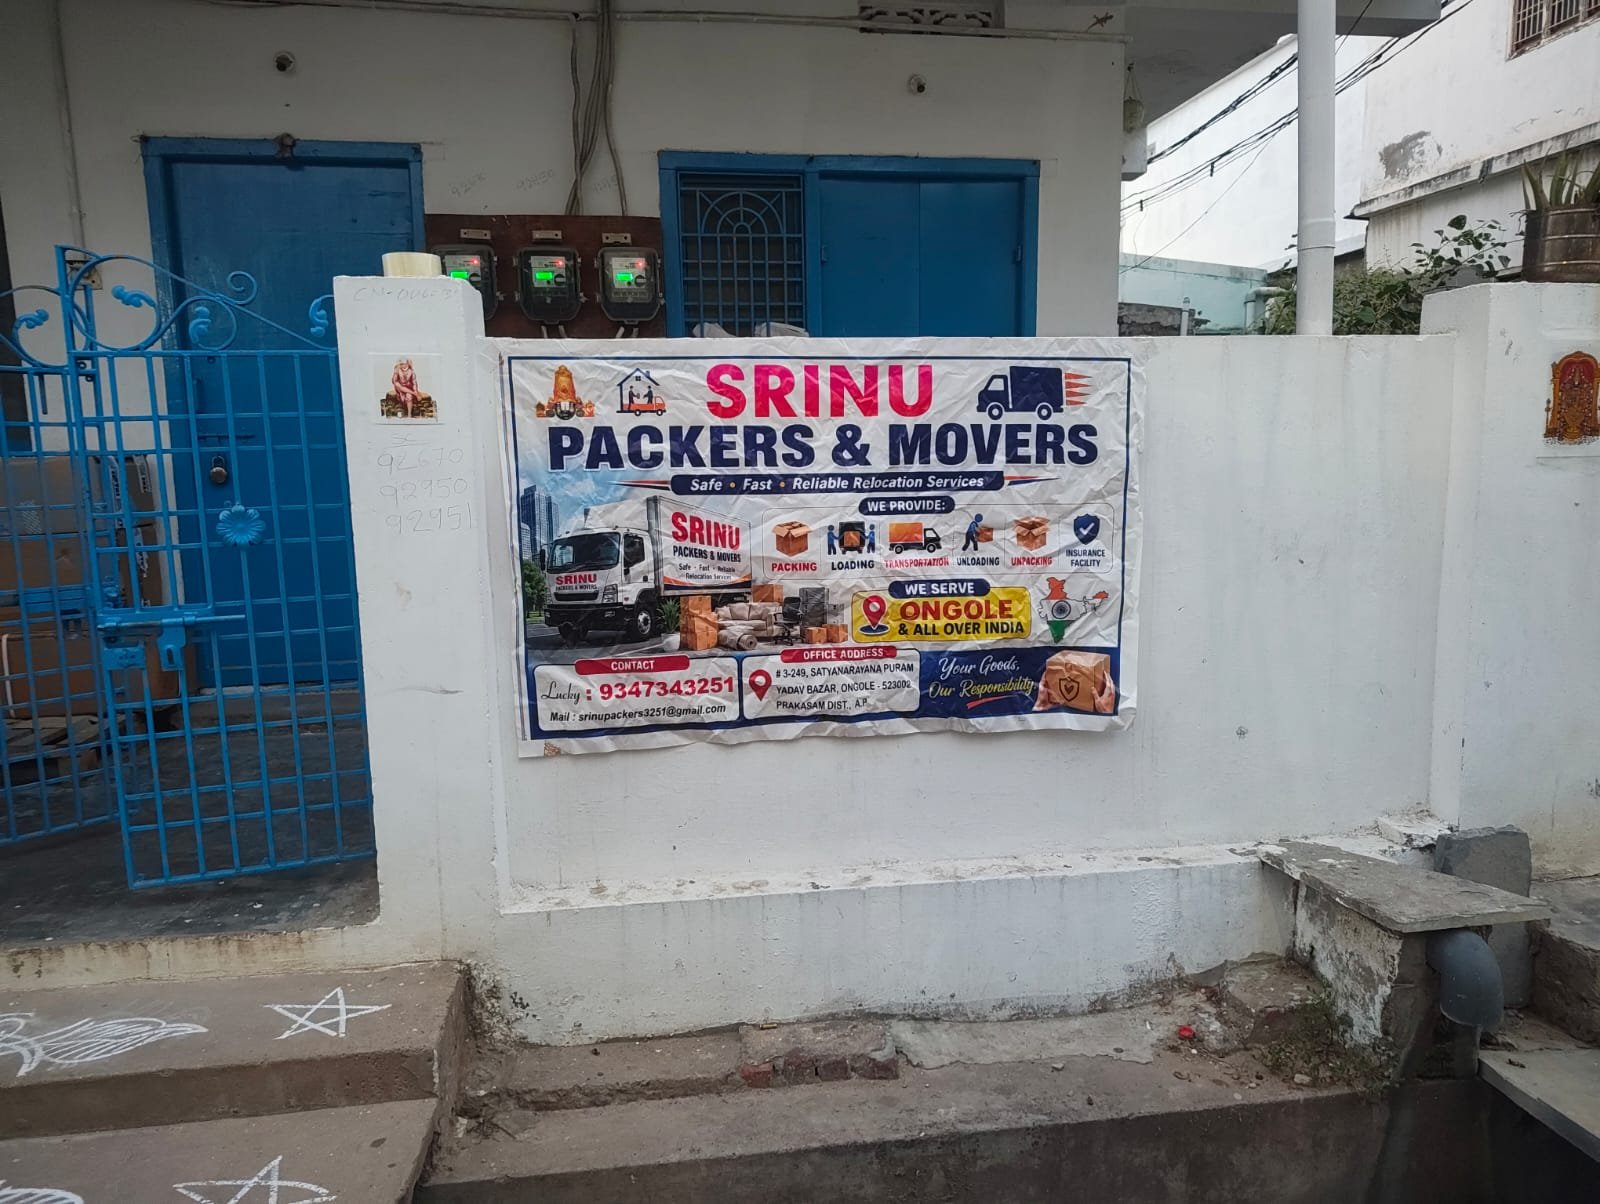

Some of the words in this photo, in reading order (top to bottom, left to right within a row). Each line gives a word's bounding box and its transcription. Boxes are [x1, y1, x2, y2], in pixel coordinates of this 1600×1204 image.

[706, 363, 933, 418] SRINU
[548, 424, 815, 470] PACKERS
[831, 424, 872, 467] &
[888, 423, 1098, 466] MOVERS
[690, 478, 723, 492] Safe
[743, 478, 772, 491] Fast
[793, 477, 849, 490] Reliable
[852, 475, 922, 489] Relocation
[928, 475, 984, 488] Services
[867, 501, 887, 512] WE
[890, 500, 945, 512] PROVIDE:
[671, 511, 741, 550] SRINU
[673, 545, 708, 559] PACKERS
[709, 550, 715, 560] &
[717, 552, 741, 562] MOVERS
[1066, 549, 1106, 558] INSURANCE
[678, 563, 691, 571] Safe
[771, 562, 817, 571] PACKING
[831, 560, 875, 570] LOADING
[884, 557, 949, 568] TRANSPORTATION
[957, 557, 1000, 566] UNLOADING
[1011, 556, 1053, 566] UNPACKING
[1071, 559, 1101, 567] FACILITY
[556, 573, 597, 585] SRINU
[905, 583, 927, 595] WE
[931, 582, 975, 594] SERVE
[900, 600, 1013, 620] ONGOLE
[898, 623, 906, 635] &
[913, 623, 939, 636] ALL
[944, 622, 980, 635] OVER
[985, 621, 1024, 634] INDIA
[803, 651, 836, 660] OFFICE
[840, 648, 883, 659] ADDRESS
[611, 660, 655, 671] CONTACT
[776, 670, 781, 678] #
[783, 668, 808, 679] 3-249,
[810, 665, 882, 677] SATYANARAYANA
[883, 663, 914, 673] PURAM
[938, 657, 977, 681] Your
[541, 681, 581, 705] Lucky
[600, 676, 734, 701] 9347343251
[776, 685, 805, 695] YADAV
[807, 683, 839, 694] BAZAR,
[841, 681, 875, 693] ONGOLE
[882, 680, 911, 690] 523002
[928, 681, 955, 699] Our
[776, 701, 825, 710] PRAKASAM
[550, 711, 570, 722] Mail
[578, 704, 726, 724] srinupackers3251@gmail.com
